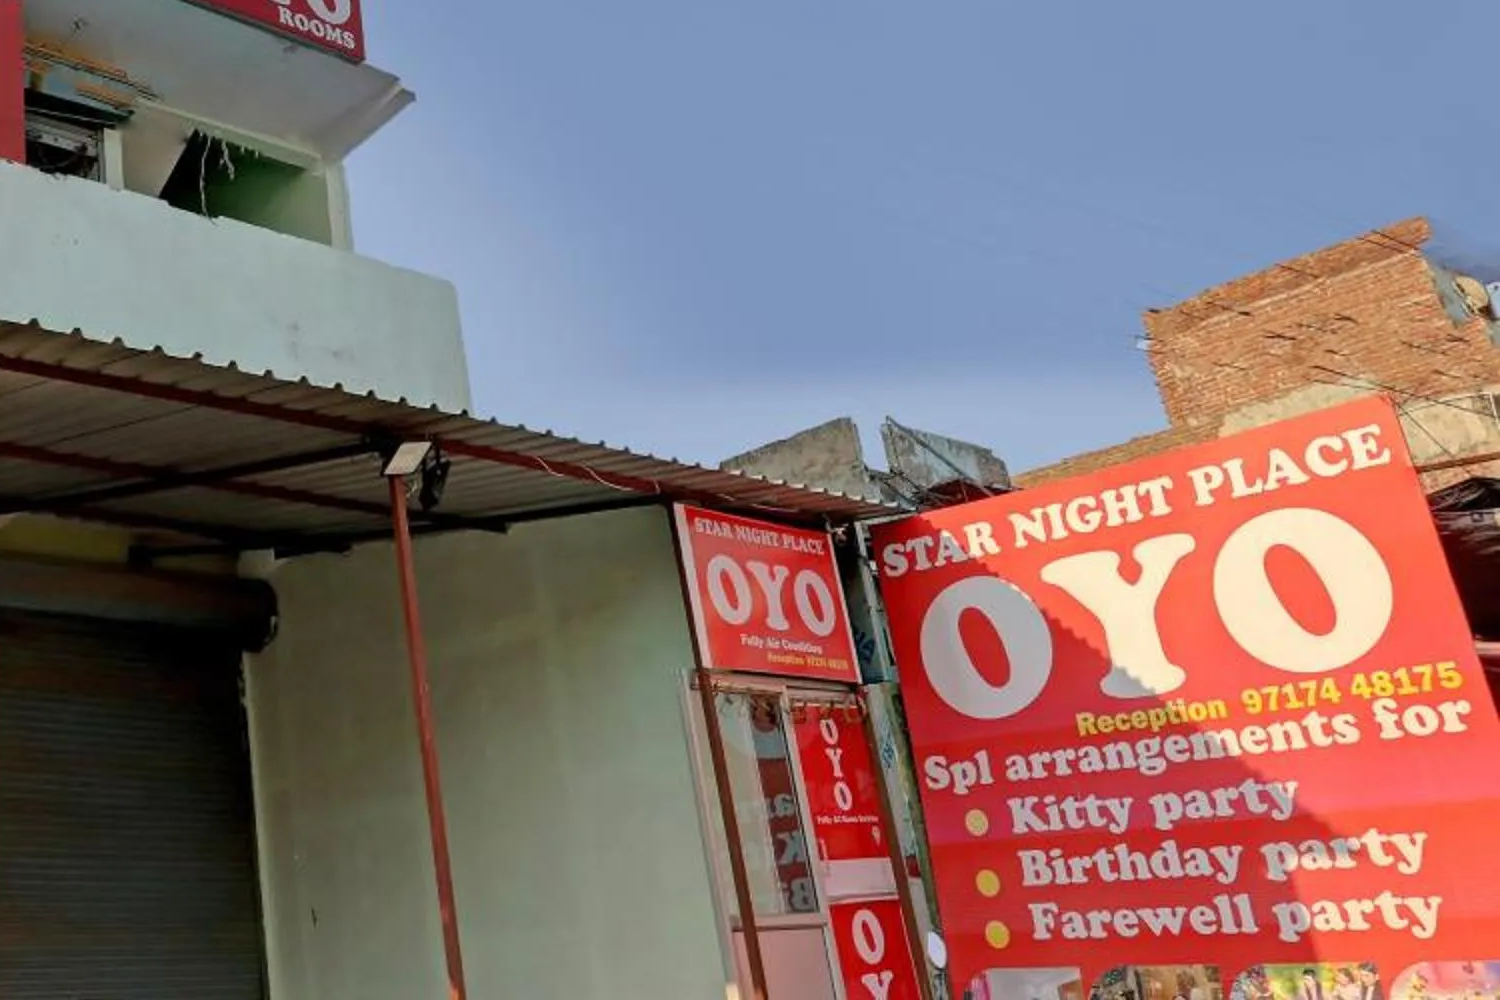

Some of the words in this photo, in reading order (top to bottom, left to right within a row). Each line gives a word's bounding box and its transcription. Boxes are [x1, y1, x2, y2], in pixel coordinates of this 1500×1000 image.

[279, 5, 356, 50] ROOMS
[882, 520, 1000, 577] STAR
[1008, 475, 1174, 549] NIGHT
[1190, 424, 1392, 508] PLACE
[694, 517, 732, 539] STAR
[735, 524, 779, 547] NIGHT
[783, 531, 826, 555] PLACE
[707, 554, 836, 637] OYO
[919, 507, 1394, 720] OYO
[740, 633, 765, 649] Fully
[1076, 697, 1228, 737] Reception
[1241, 675, 1342, 714] 97174
[1350, 661, 1463, 703] 48175
[820, 718, 853, 811] OYO
[924, 748, 994, 796] Spl
[1005, 709, 1361, 781] arrangements
[1372, 696, 1472, 740] for
[1007, 790, 1134, 834] Kitty
[1148, 777, 1299, 830] party
[1018, 843, 1243, 889] Birthday
[1259, 830, 1429, 883] party
[1028, 892, 1261, 941] Farewell
[1273, 893, 1443, 946] party
